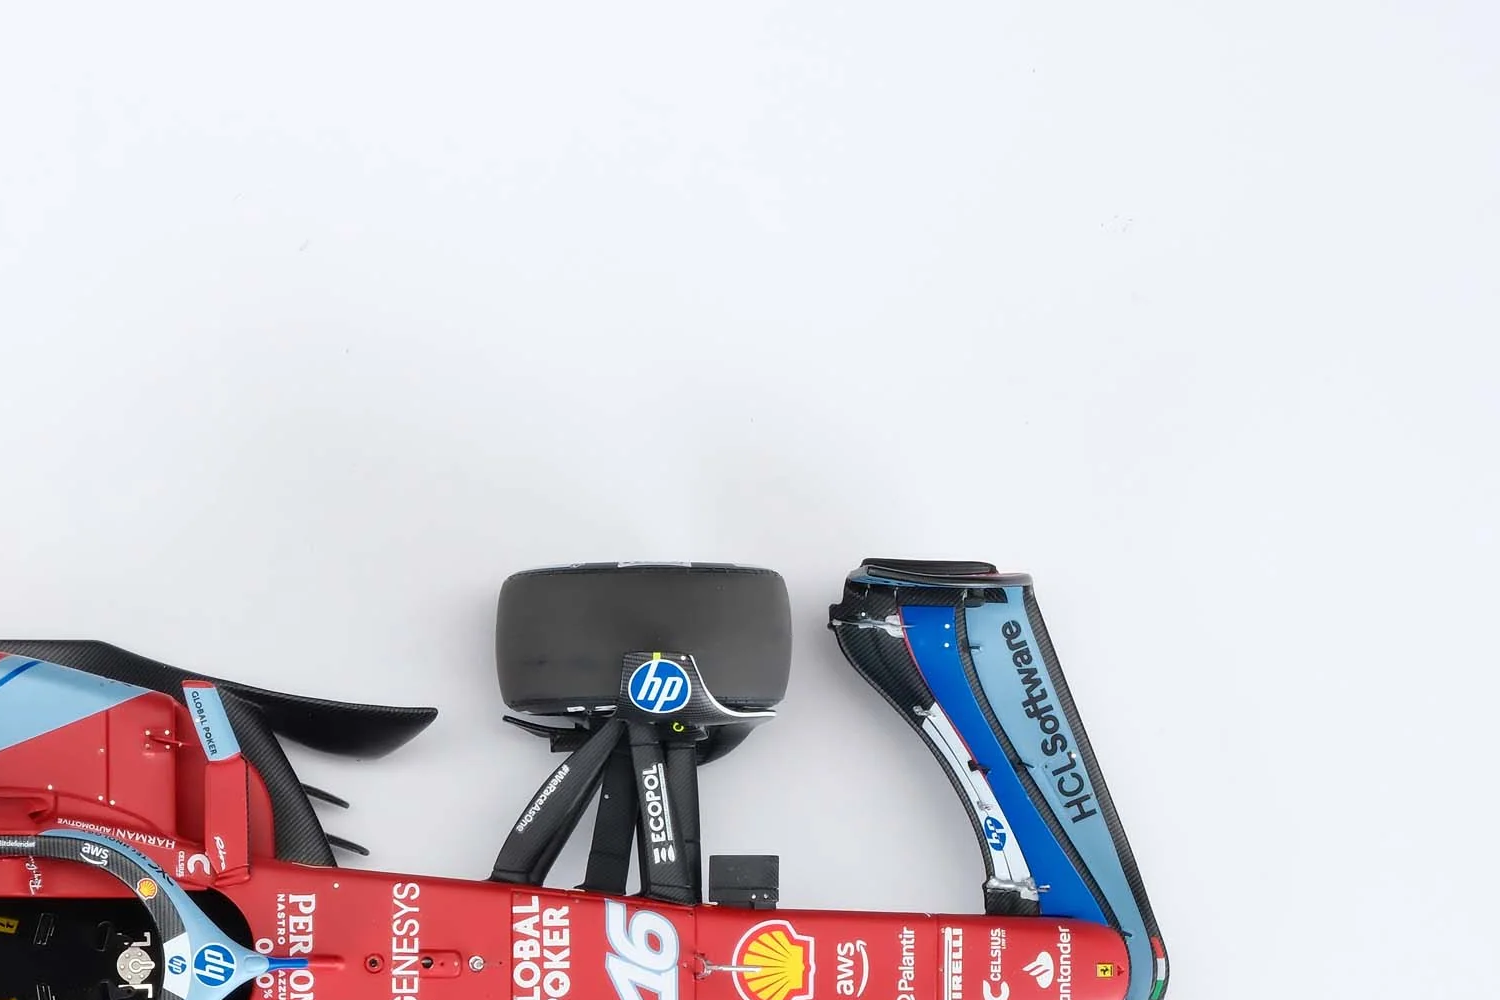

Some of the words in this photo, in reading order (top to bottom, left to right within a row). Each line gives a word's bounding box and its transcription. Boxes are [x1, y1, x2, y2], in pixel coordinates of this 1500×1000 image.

[636, 661, 684, 713] hp
[191, 690, 207, 725] GLOBAL
[204, 726, 218, 756] POKER
[1001, 620, 1097, 823] HCLSoftware
[516, 764, 571, 833] #WeRaceAsOne
[643, 764, 667, 843] ECOPOL
[57, 818, 113, 834] AUTOMOTIVE
[81, 842, 110, 861] aws
[116, 828, 176, 849] HARMAN
[277, 893, 286, 945] NASTRO
[169, 956, 187, 975] hp
[202, 949, 236, 982] hp
[836, 942, 856, 996] aws
[898, 926, 915, 992] Palantir
[990, 928, 1002, 981] CELSIUS
